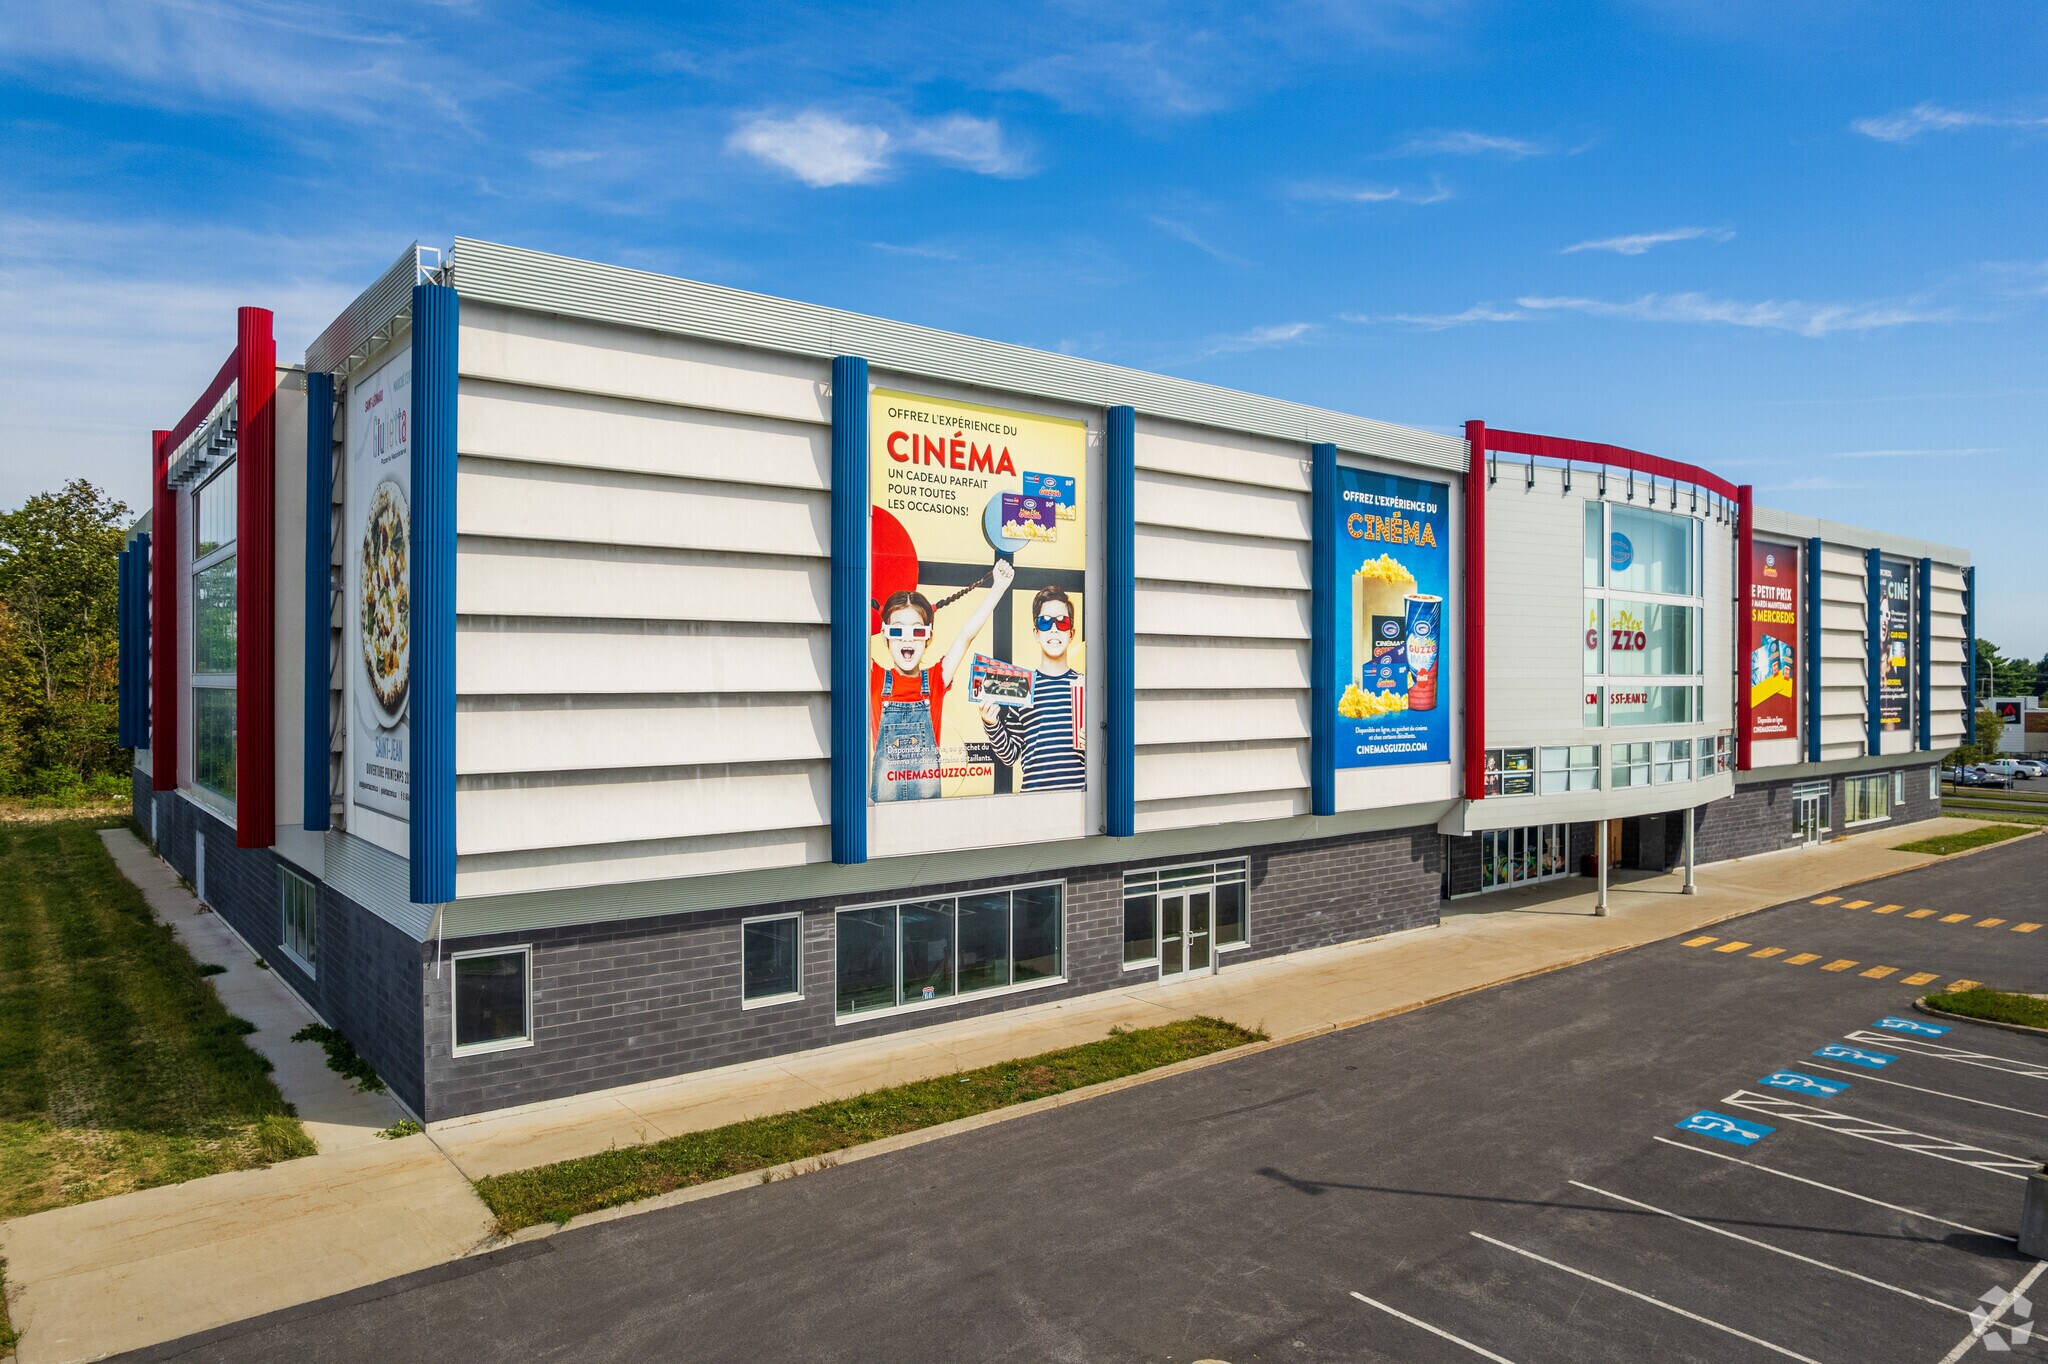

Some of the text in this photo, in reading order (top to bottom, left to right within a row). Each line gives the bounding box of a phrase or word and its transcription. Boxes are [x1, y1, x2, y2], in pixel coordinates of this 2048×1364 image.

[888, 407, 1017, 436] OFFREZ L'EXPÉRIENCE DU
[887, 430, 1017, 477] CINÉMA
[888, 468, 988, 489] UN CADEAU PARFAIT
[888, 484, 956, 500] POUR TOUTES
[888, 499, 969, 516] LES OCCASIONS!
[1343, 490, 1437, 514] OFFREZ L'EXPÉRIENCE DU
[1347, 511, 1437, 548] CINÉMA
[1757, 585, 1775, 599] PETIT
[1776, 587, 1792, 602] PRIX
[1888, 577, 1909, 601] CINÉ
[1757, 609, 1795, 624] MERCREDIS
[1586, 629, 1647, 651] GZZO
[1409, 644, 1437, 654] GUZZO
[982, 743, 990, 751] du
[1356, 742, 1428, 755] CINEMASGUZZO.COM
[887, 767, 992, 782] CINEMASGUZZO.COM
